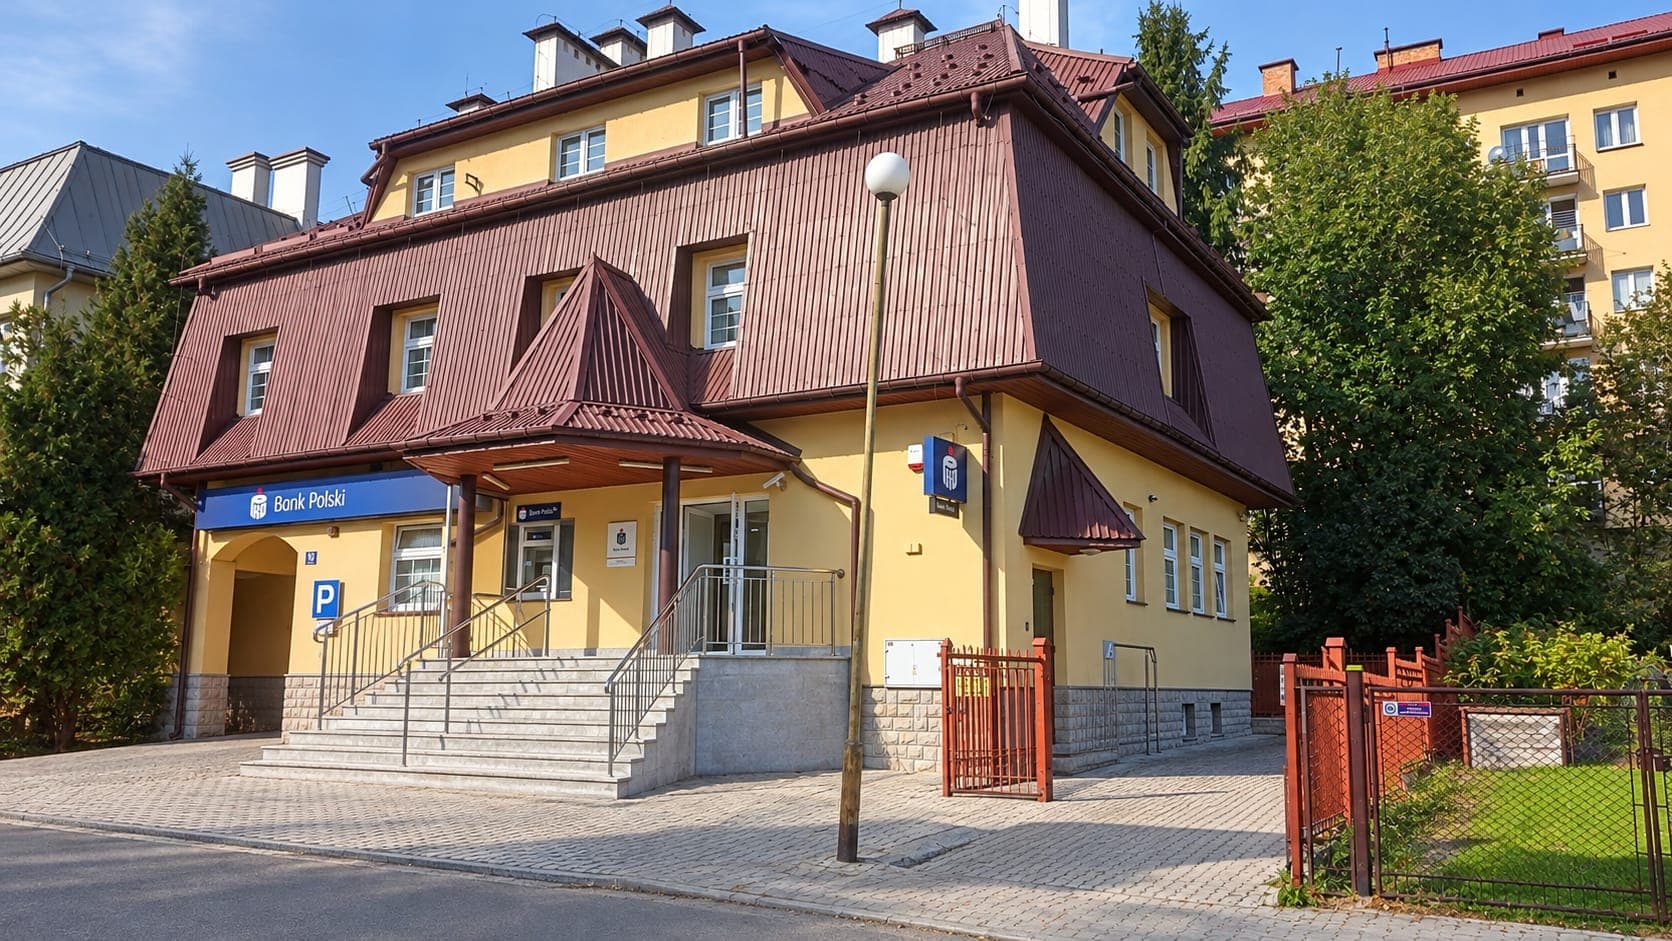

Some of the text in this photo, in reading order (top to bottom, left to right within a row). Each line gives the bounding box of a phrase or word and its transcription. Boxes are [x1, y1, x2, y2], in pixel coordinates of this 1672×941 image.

[274, 492, 305, 512] Bank
[309, 489, 346, 509] Polski
[316, 584, 334, 614] P
